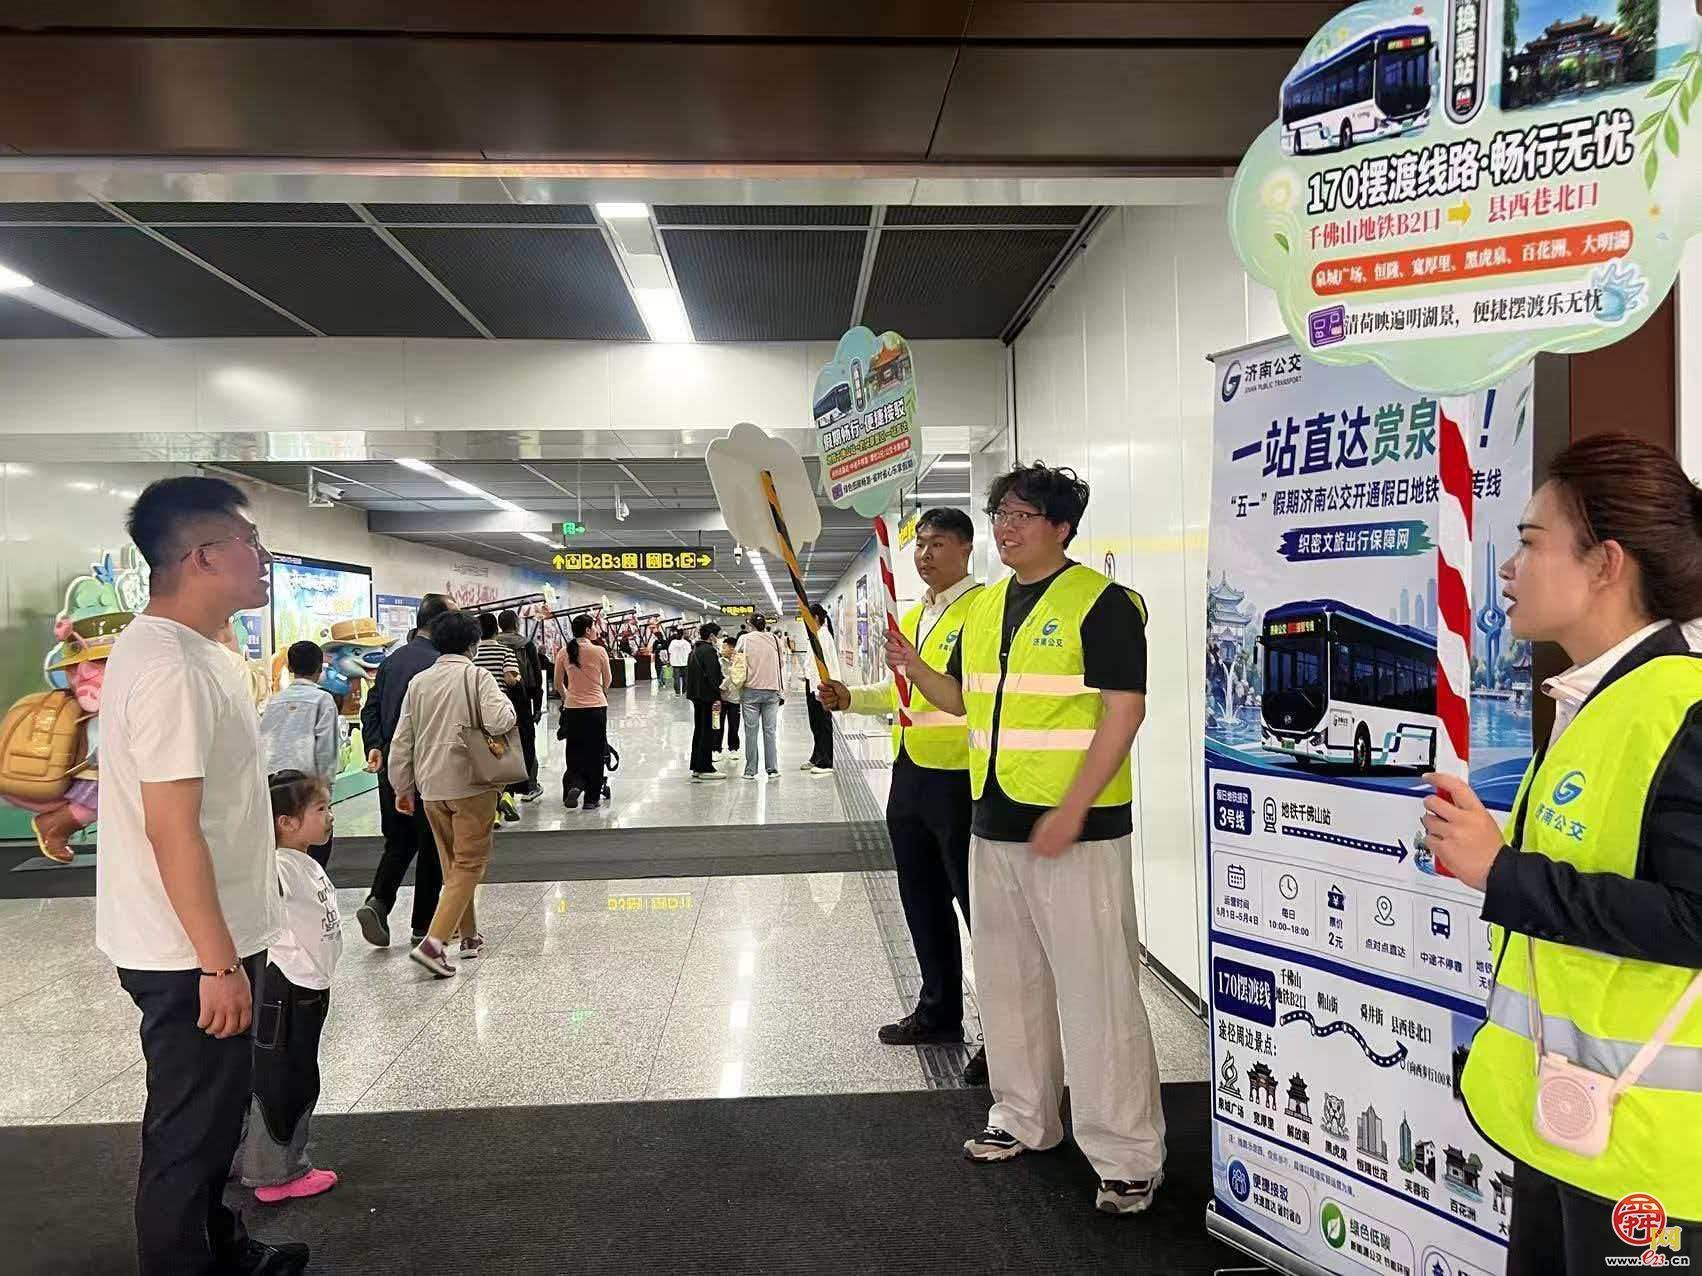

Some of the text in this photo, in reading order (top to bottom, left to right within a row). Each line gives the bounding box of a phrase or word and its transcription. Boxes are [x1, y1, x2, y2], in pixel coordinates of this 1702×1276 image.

[1307, 109, 1635, 214] 170摆渡线路·畅行无忧
[1310, 183, 1598, 249] 千佛山地铁B2口 县西巷北口
[1245, 353, 1301, 382] 济南公交
[1299, 527, 1409, 553] 织密文旅出行保障网
[663, 553, 680, 568] B1
[1219, 806, 1245, 831] 3号线
[1281, 801, 1331, 826] 地铁千佛山站
[1535, 803, 1587, 841] 济南公交
[1328, 932, 1344, 949] 2元
[1365, 938, 1407, 959] 点对点直达
[1350, 1218, 1391, 1252] 绿色低碳
